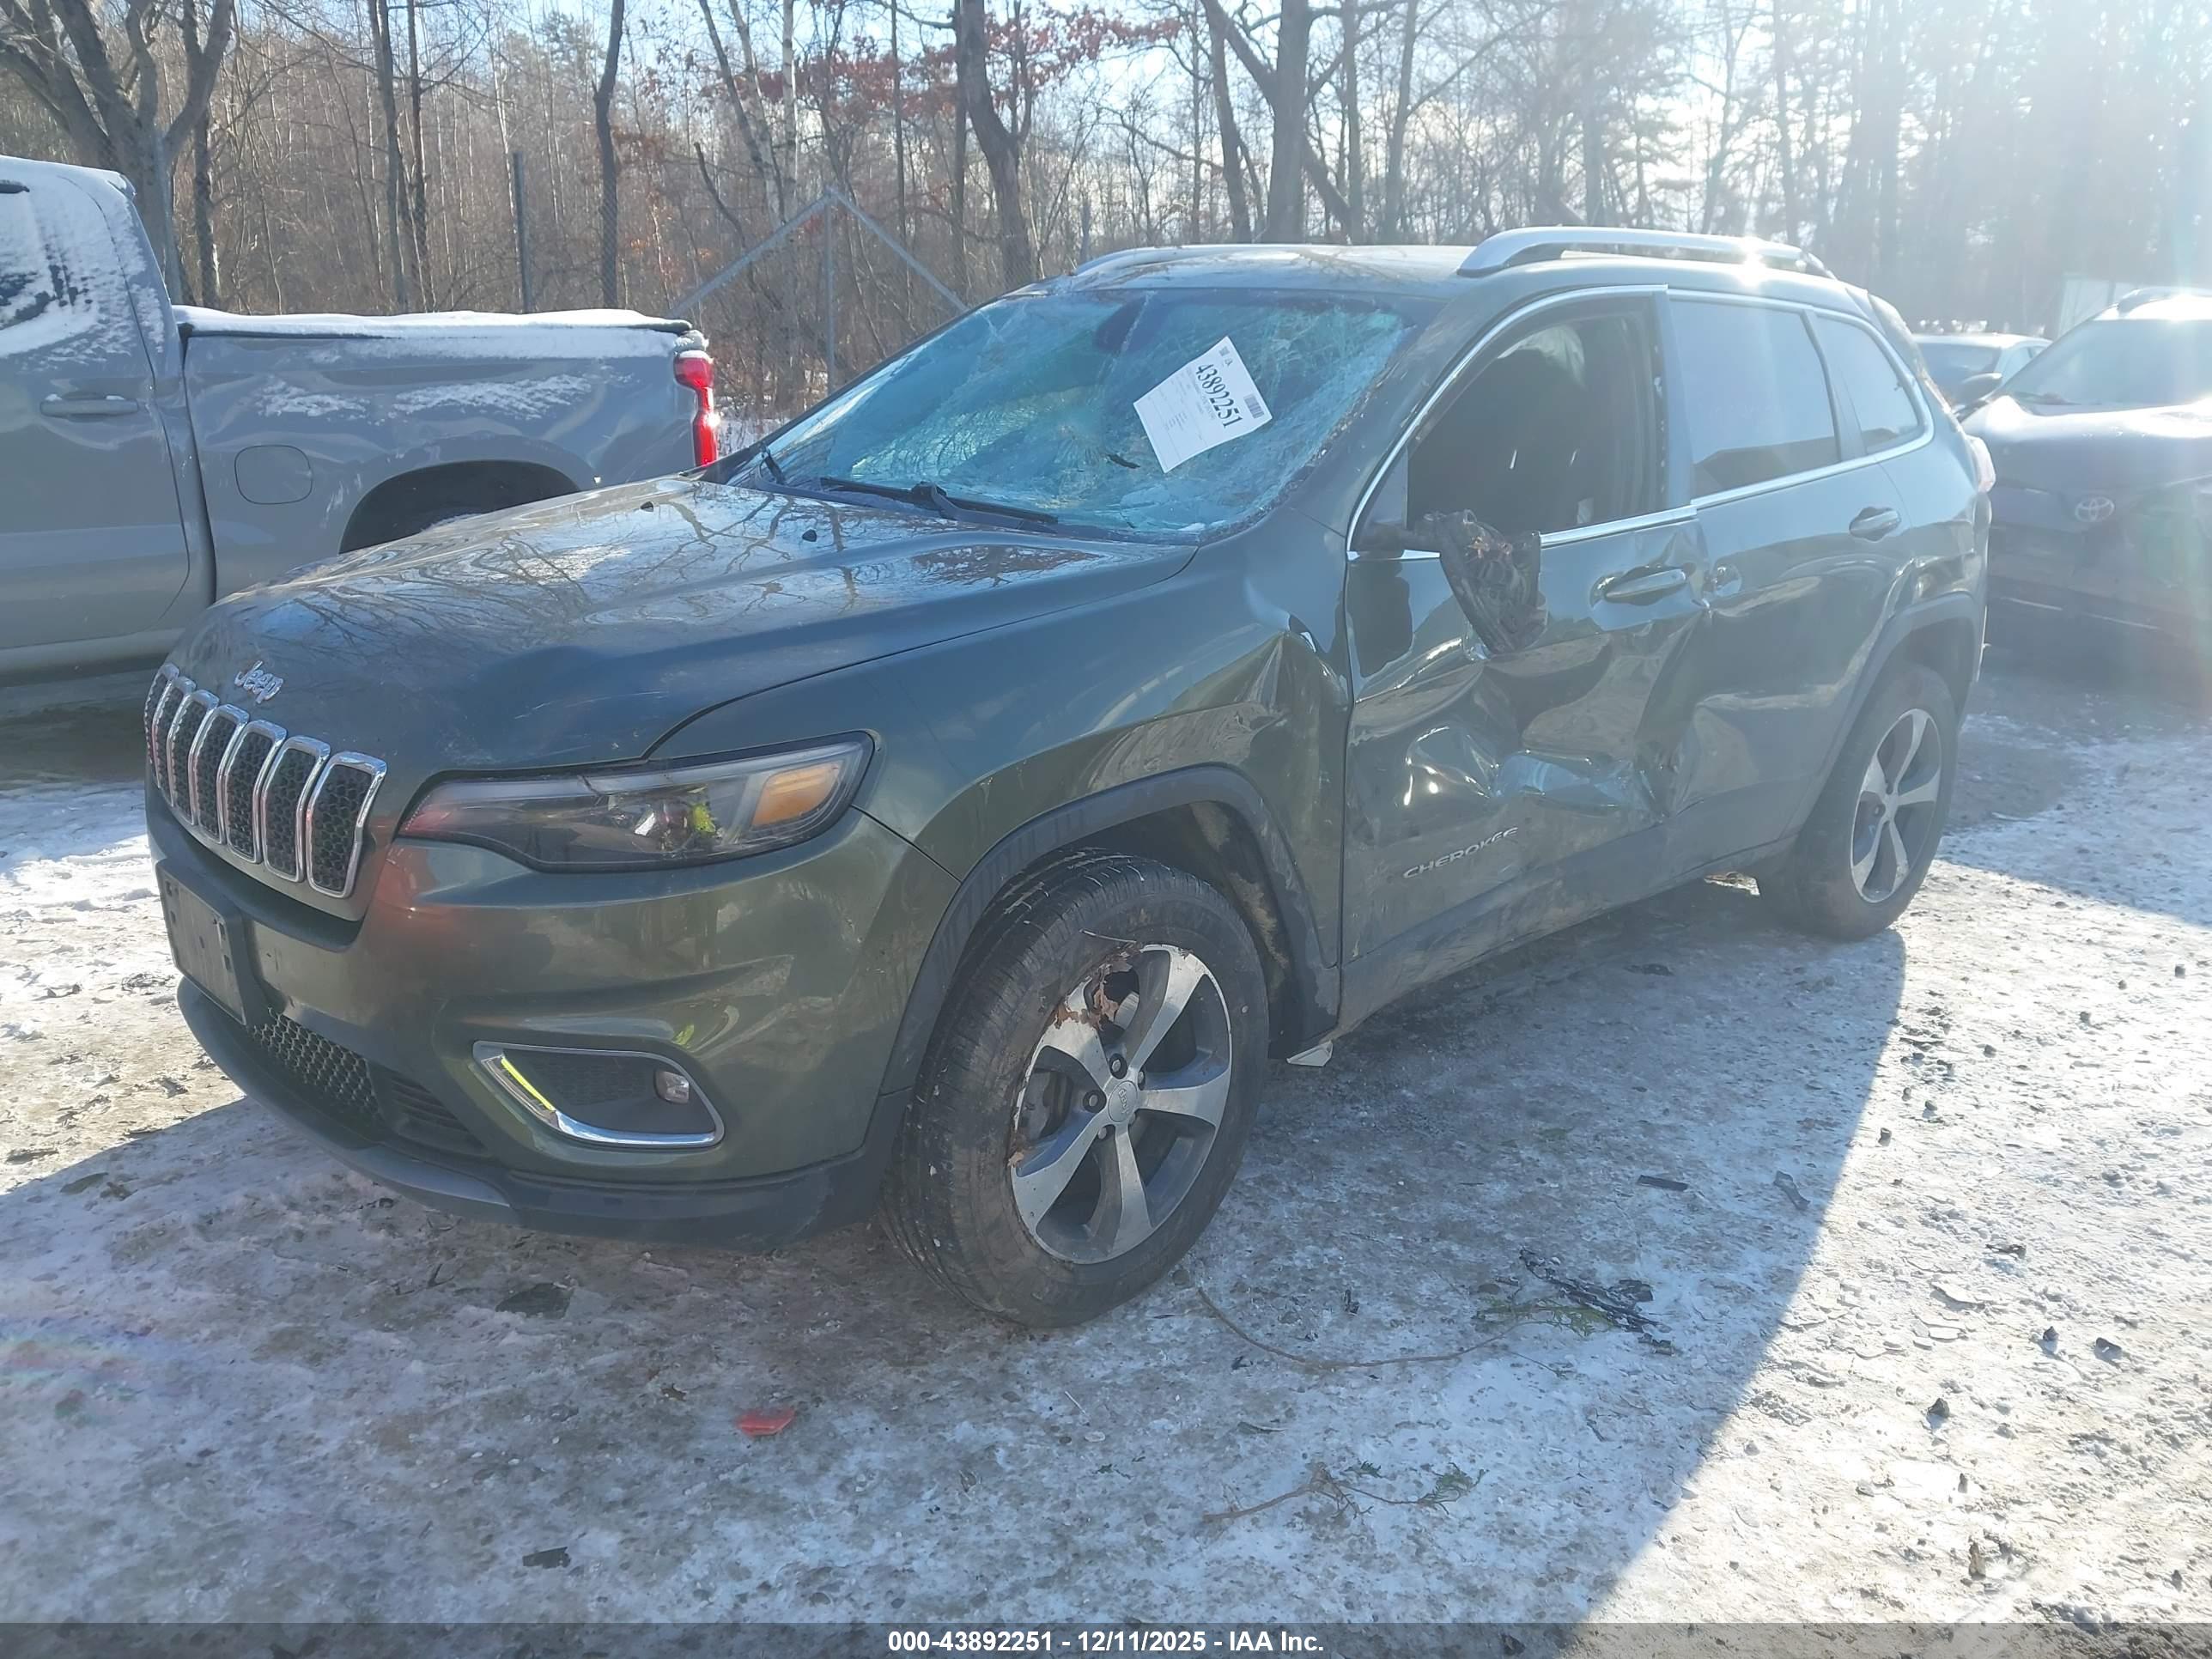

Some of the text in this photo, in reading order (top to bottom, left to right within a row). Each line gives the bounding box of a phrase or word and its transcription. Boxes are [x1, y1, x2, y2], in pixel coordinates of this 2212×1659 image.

[1195, 364, 1243, 428] 43892251
[234, 660, 283, 704] Jeep
[1402, 827, 1518, 879] CHEROKEE
